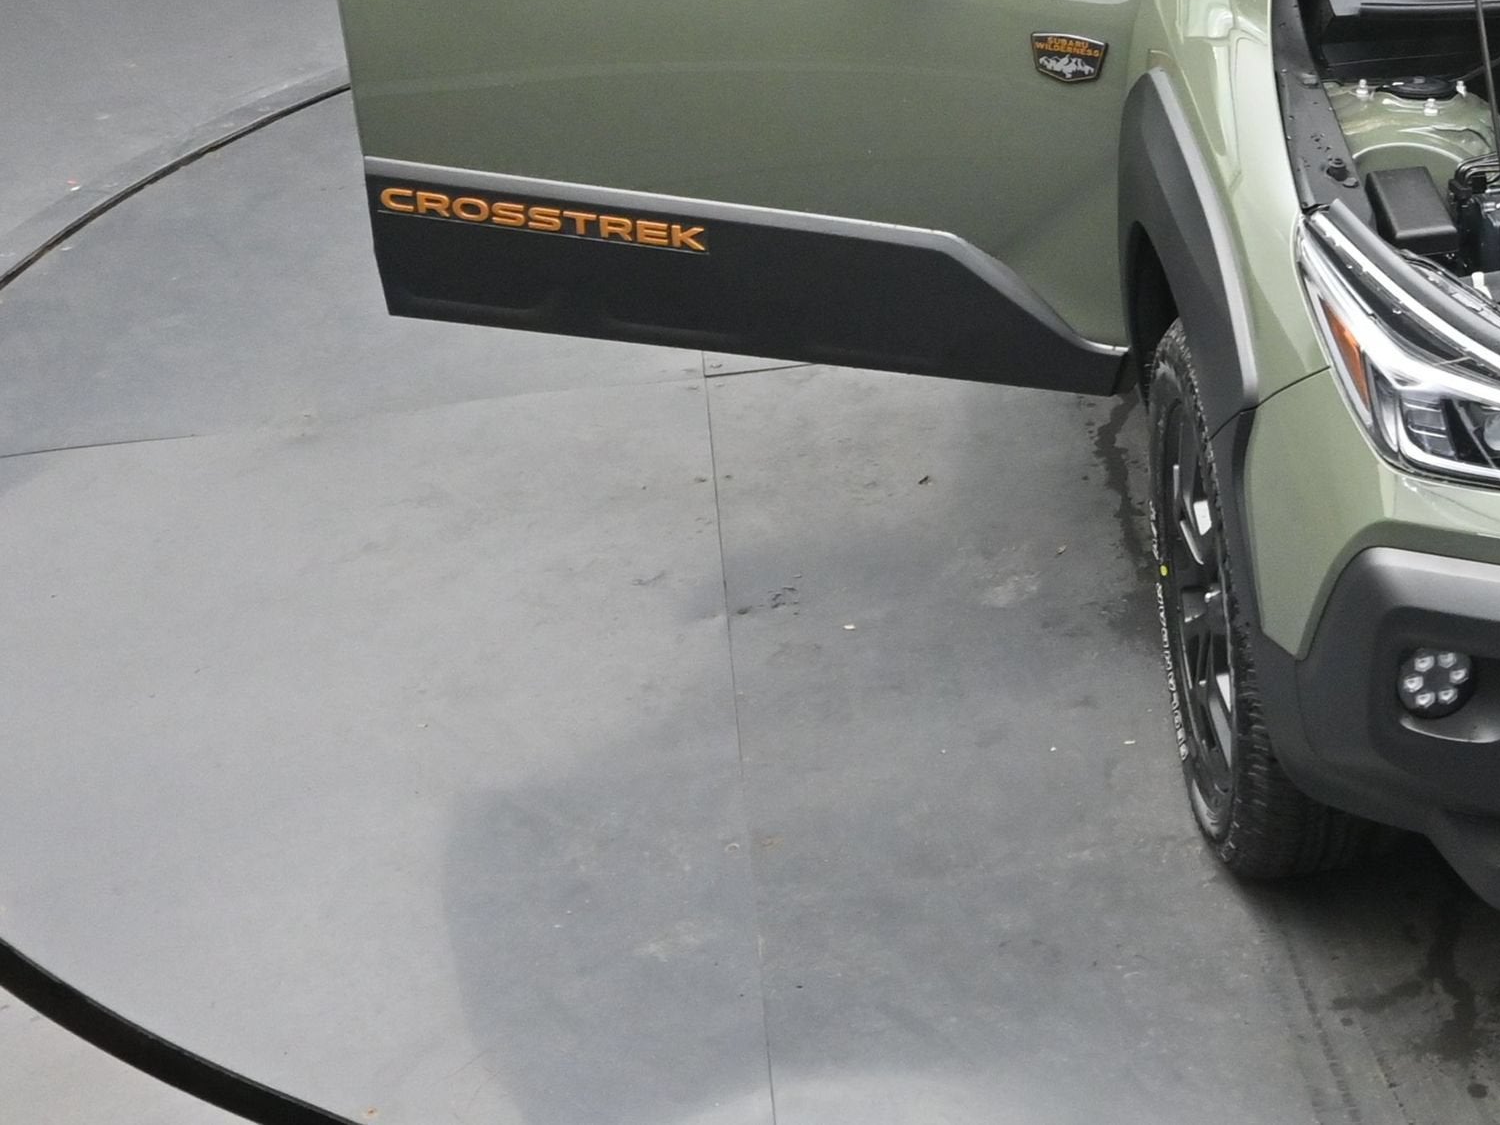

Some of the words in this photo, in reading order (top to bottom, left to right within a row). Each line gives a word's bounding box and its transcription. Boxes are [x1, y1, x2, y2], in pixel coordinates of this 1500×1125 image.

[1035, 41, 1100, 57] WILDERNESS
[1047, 36, 1089, 48] SUBARU
[379, 187, 706, 252] CROSSTREK
